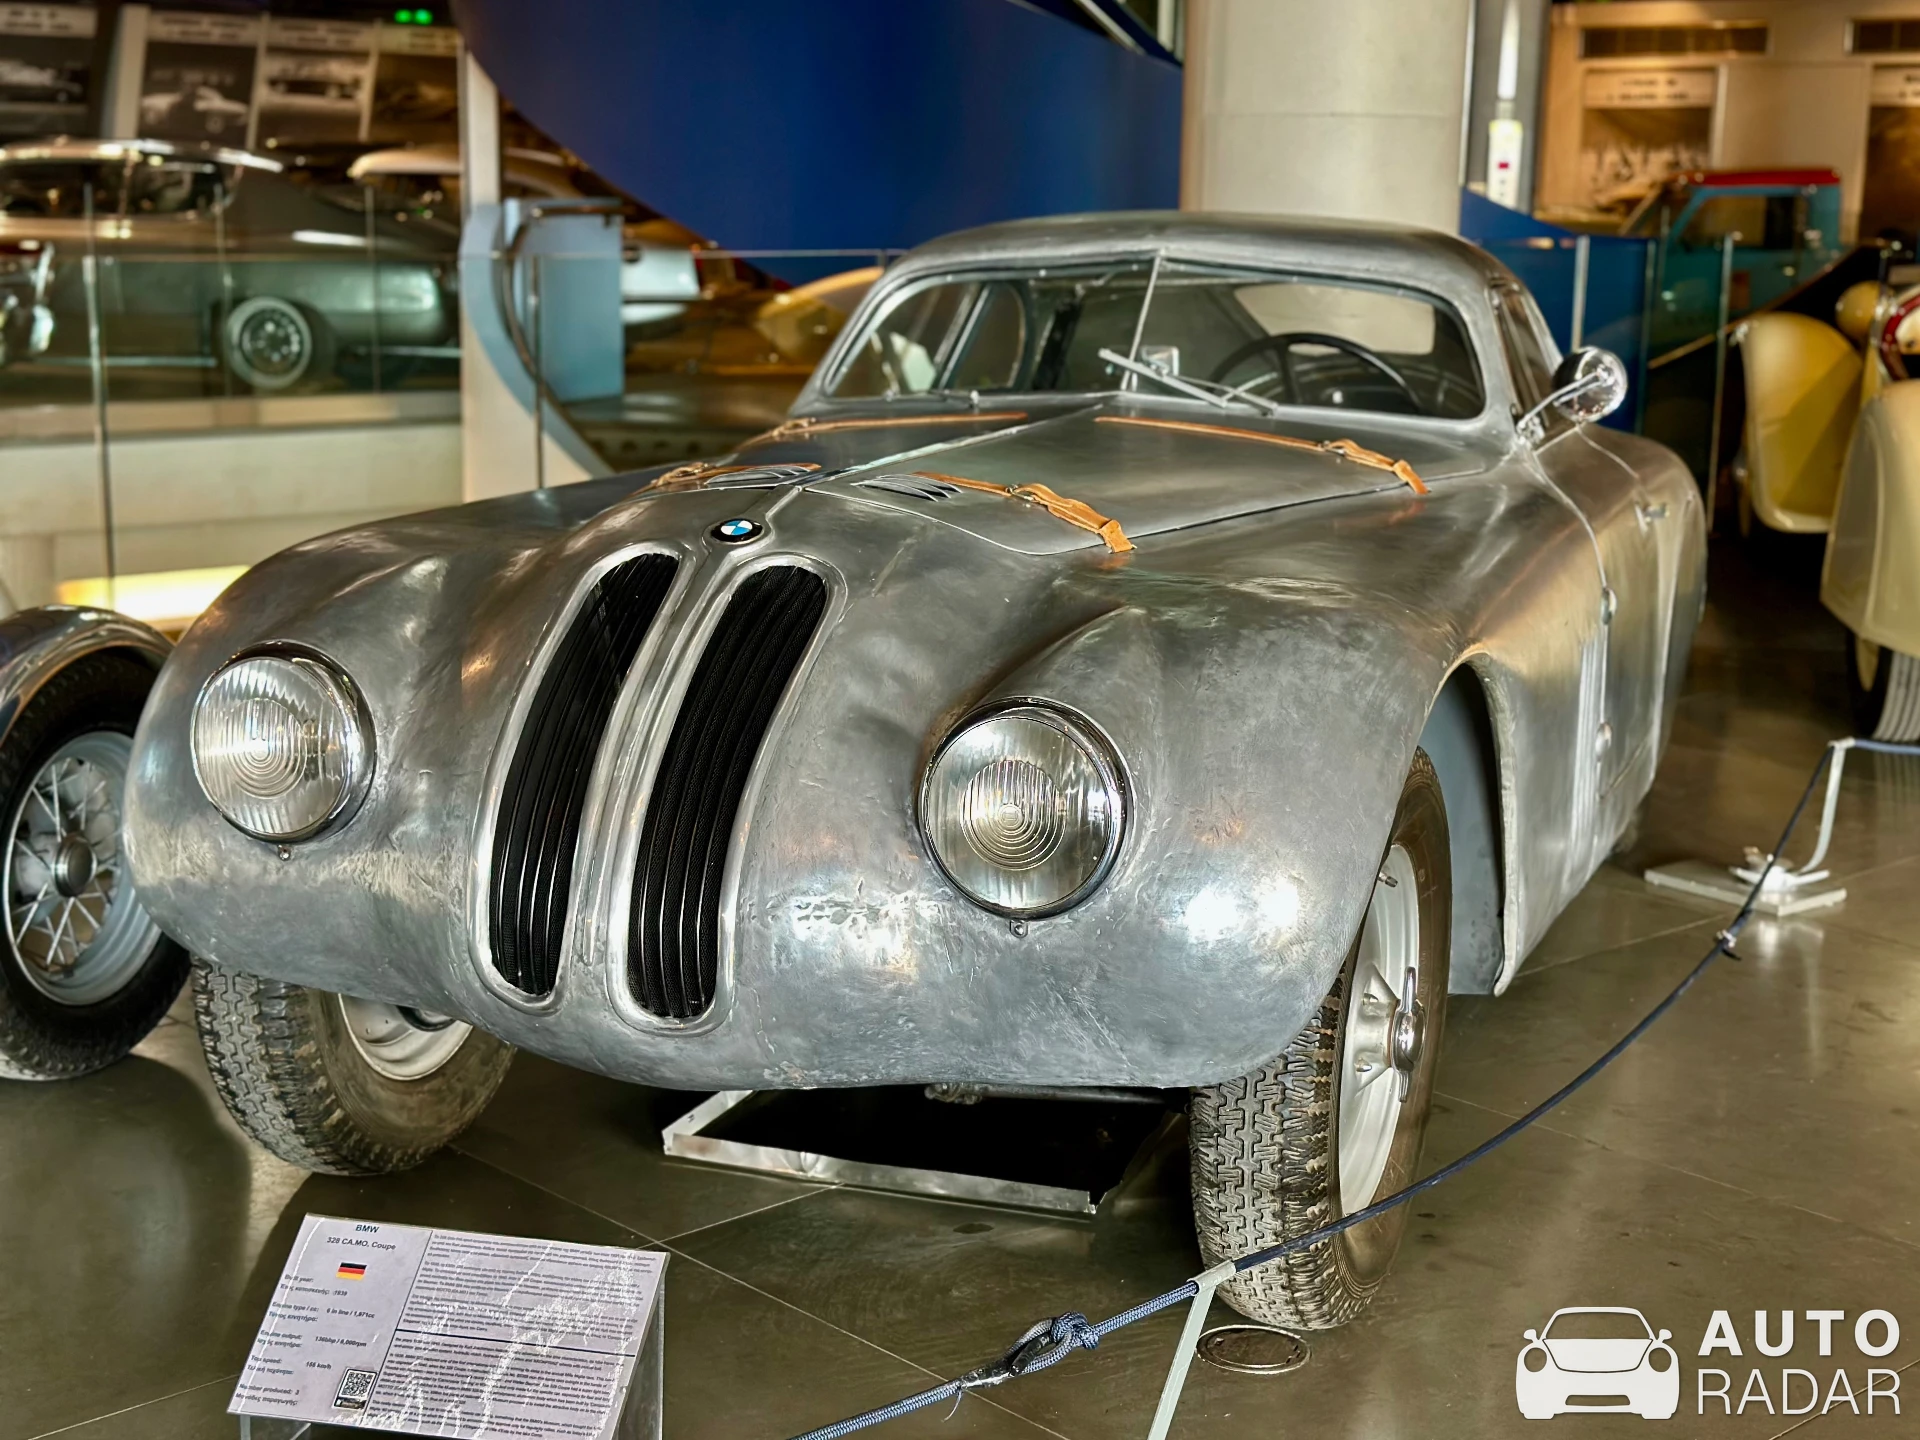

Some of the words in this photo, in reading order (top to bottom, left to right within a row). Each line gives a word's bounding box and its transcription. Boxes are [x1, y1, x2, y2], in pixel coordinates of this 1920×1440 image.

[355, 1224, 380, 1233] BMW
[326, 1236, 340, 1244] 328
[371, 1239, 396, 1250] Coupe
